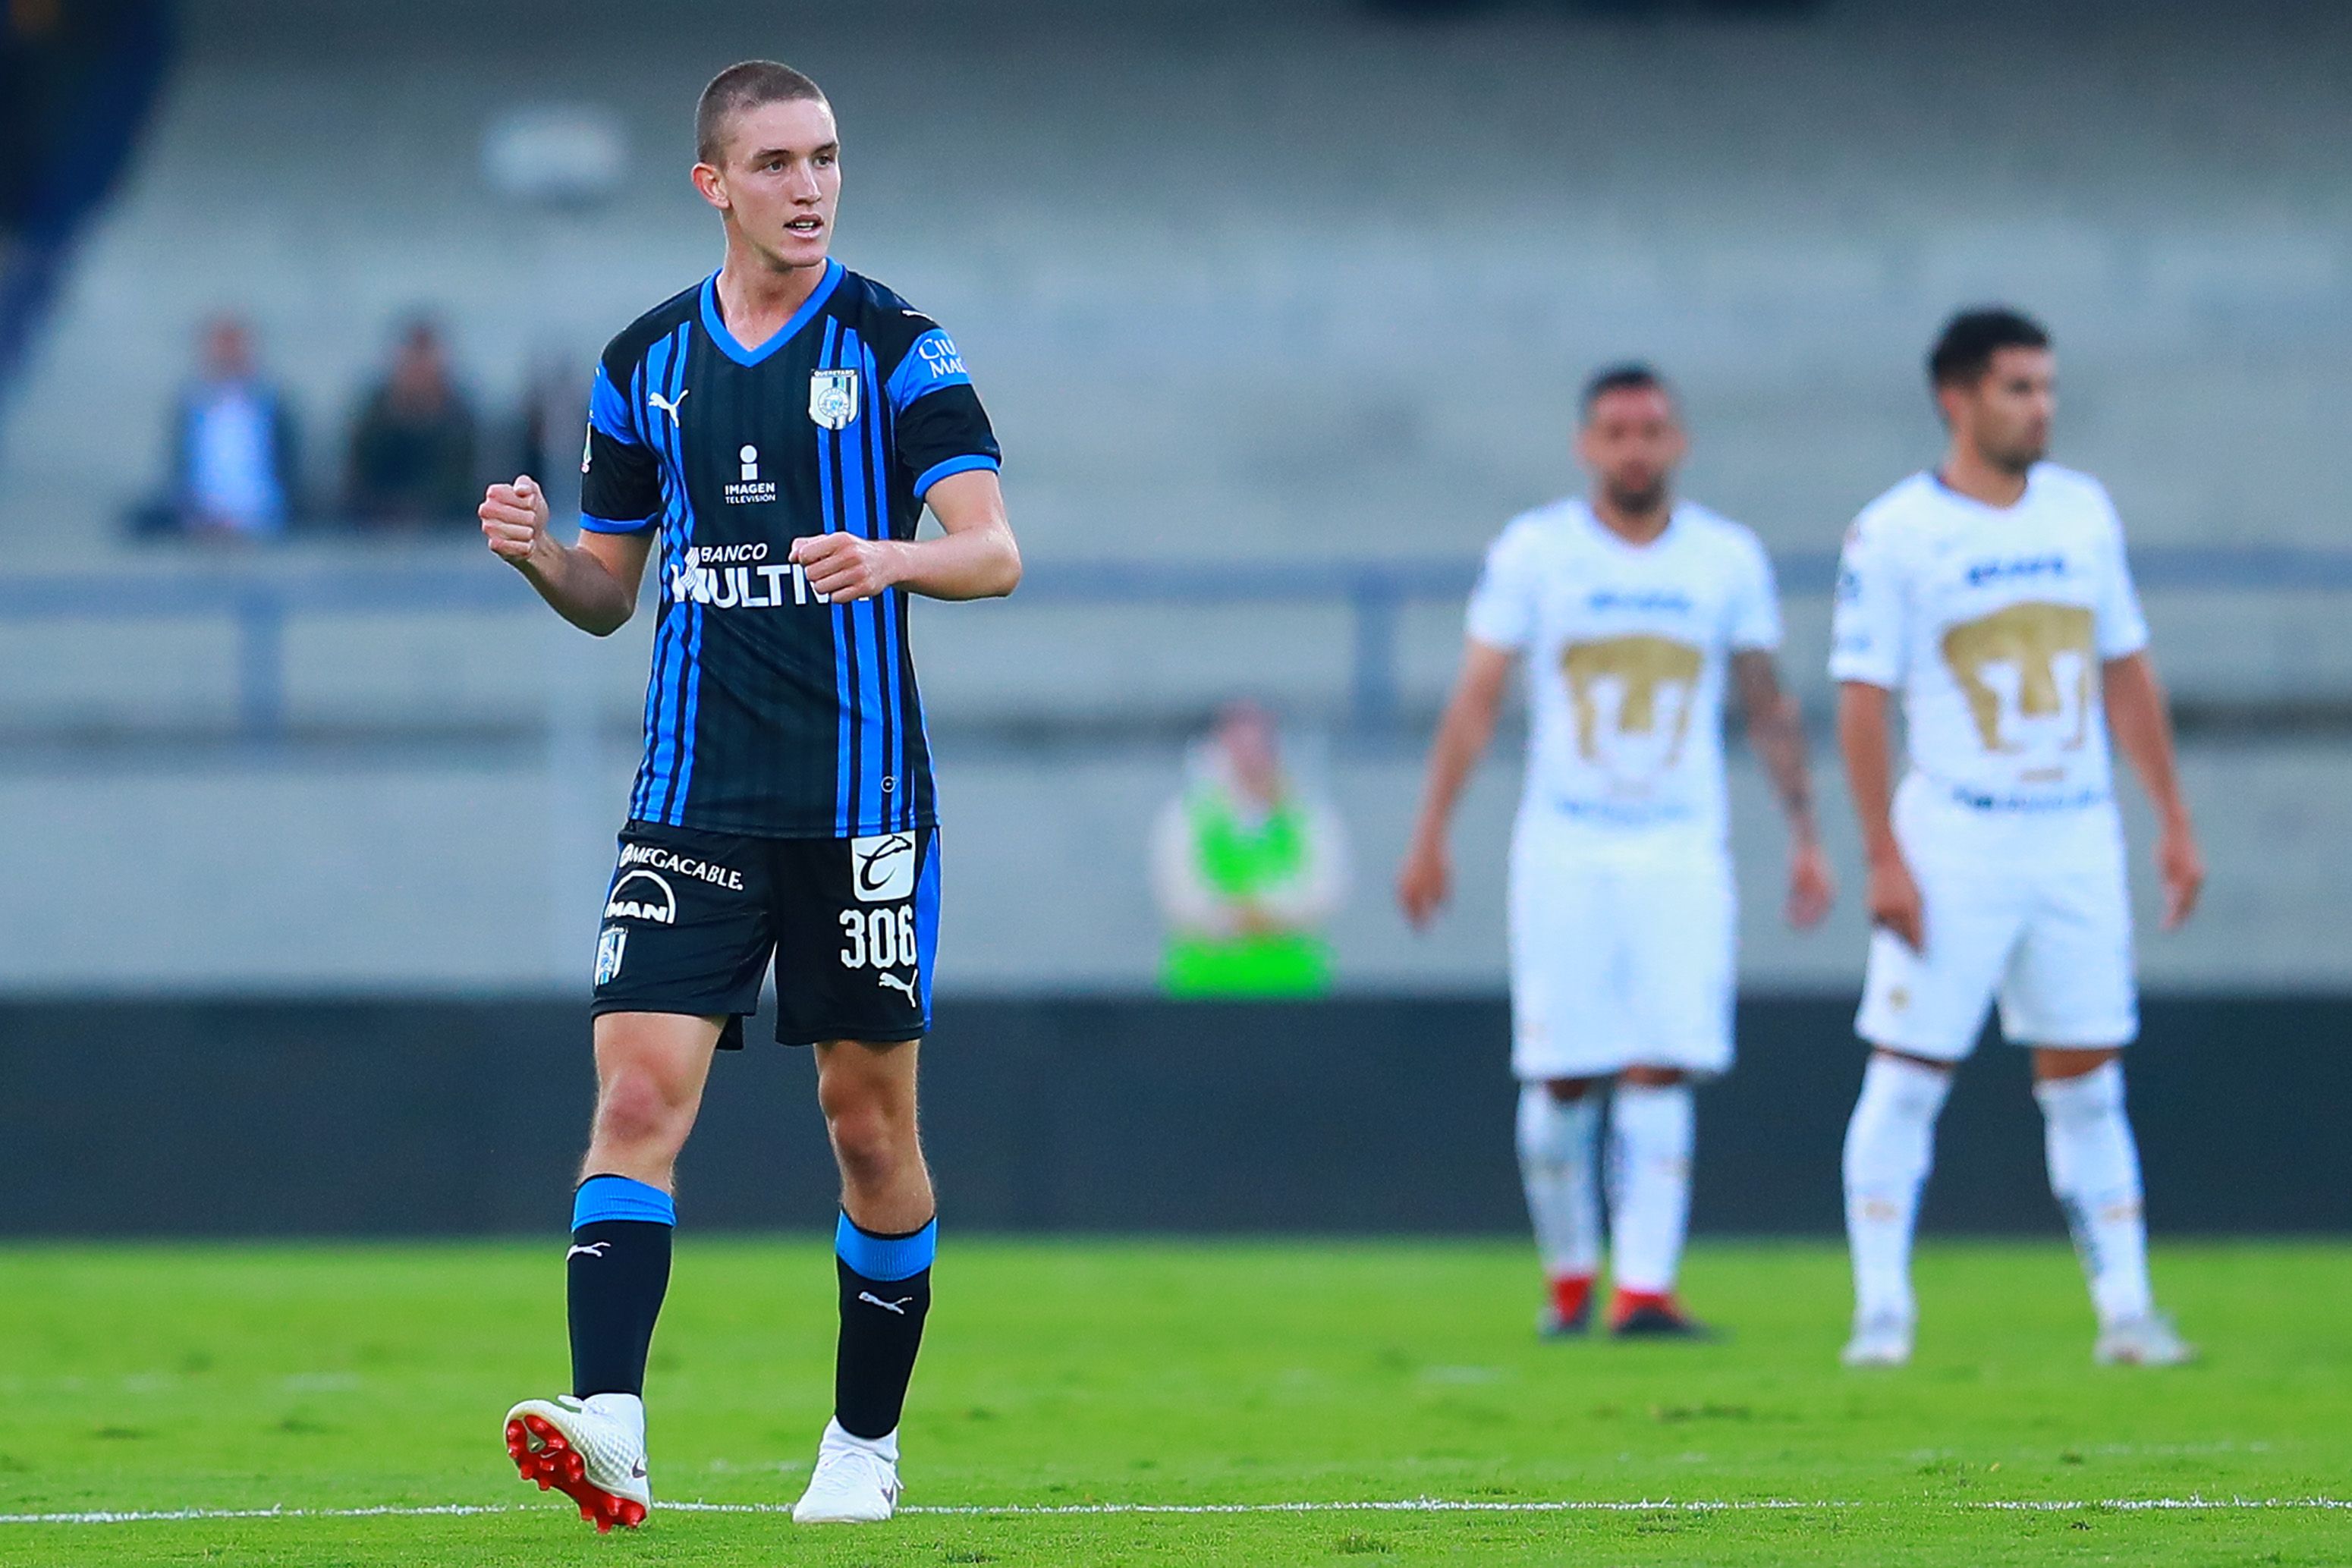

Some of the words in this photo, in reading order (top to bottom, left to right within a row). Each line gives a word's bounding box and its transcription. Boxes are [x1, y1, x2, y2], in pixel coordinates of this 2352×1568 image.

[725, 482, 775, 495] IMAGEN
[701, 543, 768, 563] BANCO
[605, 901, 668, 922] MAN
[839, 904, 917, 969] 306
